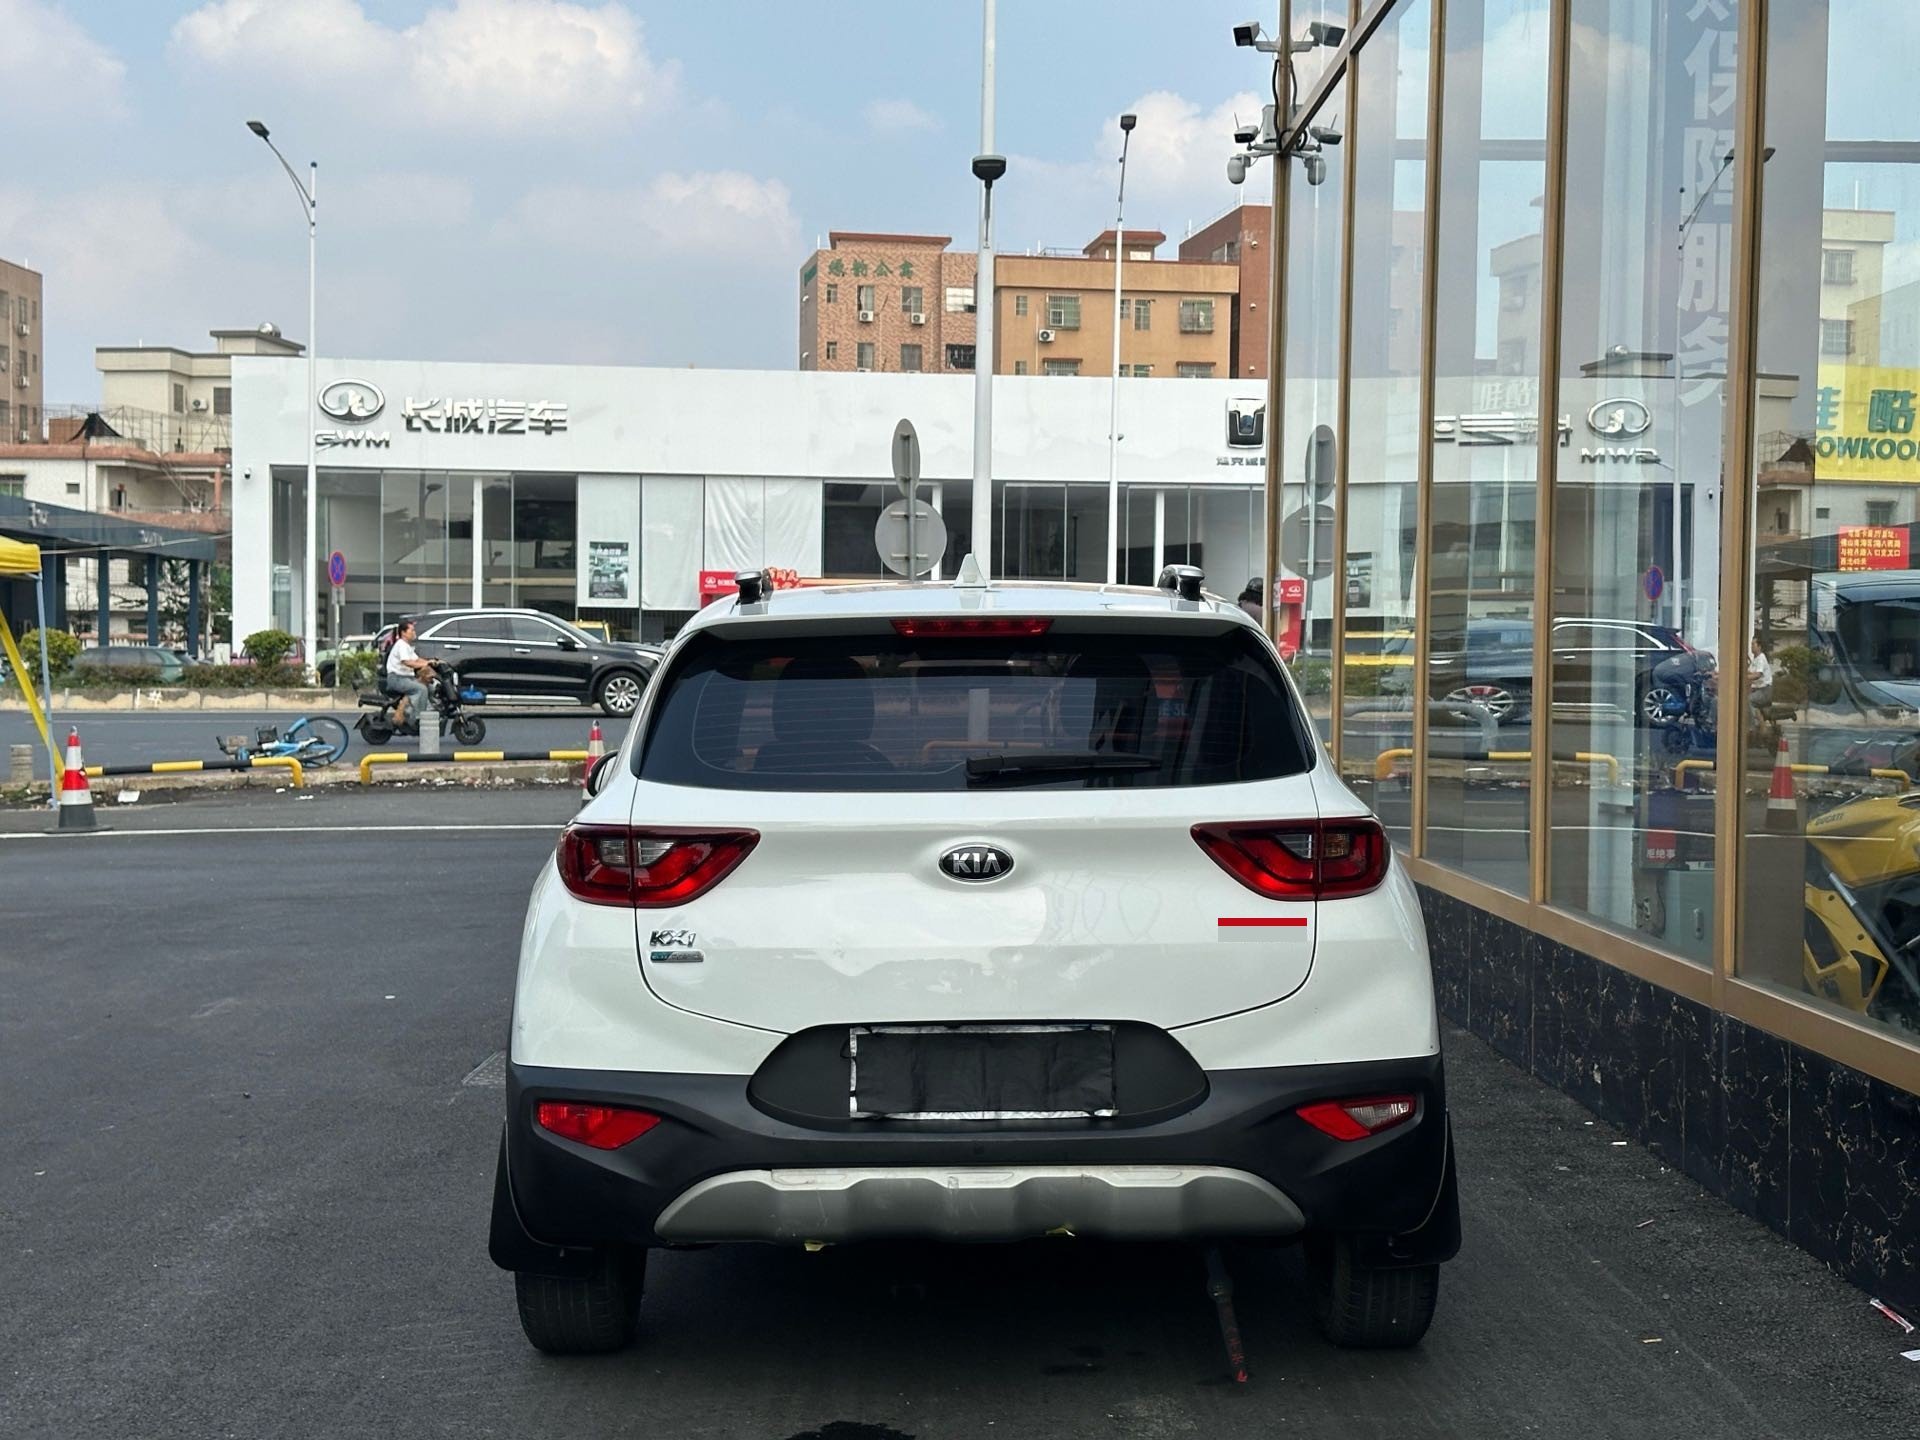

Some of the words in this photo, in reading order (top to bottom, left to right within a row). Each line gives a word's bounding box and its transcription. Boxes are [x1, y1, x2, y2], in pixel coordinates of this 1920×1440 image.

[1678, 0, 1738, 408] 保障服务
[401, 396, 568, 435] 长城汽车
[315, 429, 391, 453] GWM
[1816, 436, 1920, 461] OWKOO
[952, 852, 1002, 873] KIA
[649, 930, 697, 948] KX1
